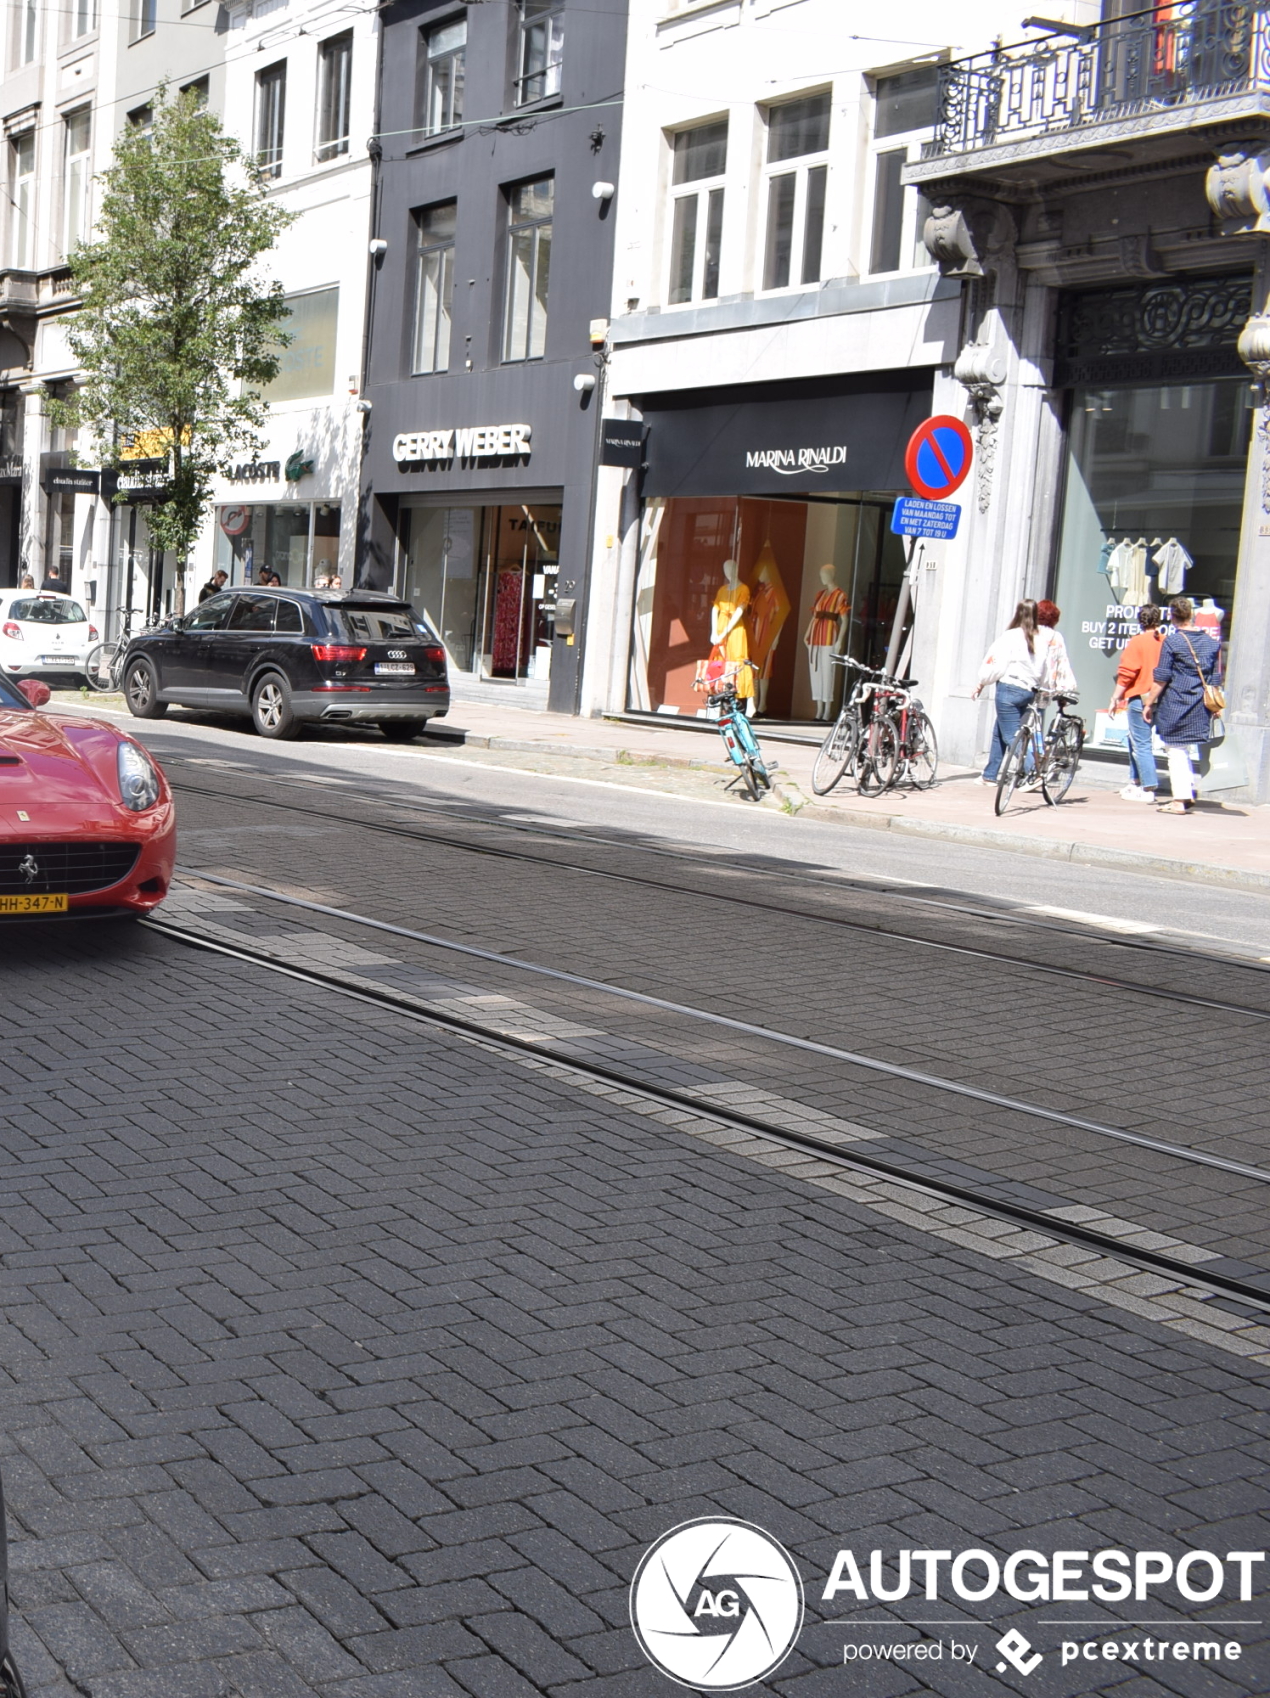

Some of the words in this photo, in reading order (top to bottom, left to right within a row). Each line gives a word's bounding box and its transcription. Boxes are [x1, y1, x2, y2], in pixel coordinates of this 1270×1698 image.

[392, 429, 454, 462] GERRY
[455, 424, 532, 457] WEBER
[745, 444, 796, 472] MARINA
[798, 441, 847, 469] RINALDI
[228, 460, 280, 480] LACOSTE
[904, 499, 924, 509] LADEN
[925, 502, 933, 510] EN
[934, 503, 957, 513] LOSSEN
[901, 508, 913, 516] VAN
[914, 509, 944, 520] MAANDAG
[945, 513, 957, 521] TOT
[509, 518, 562, 533] TAIFU
[900, 516, 909, 525] EN
[909, 517, 922, 526] MET
[922, 519, 954, 530] ZATERDAG
[904, 526, 916, 534] VAN
[917, 527, 922, 535] 7
[923, 528, 934, 536] TOT
[934, 529, 941, 537] 19
[941, 530, 947, 538] U
[1081, 621, 1106, 634] BUY
[1107, 622, 1116, 634] 2
[1089, 637, 1113, 649] GET
[0, 896, 64, 911] HH-347-N
